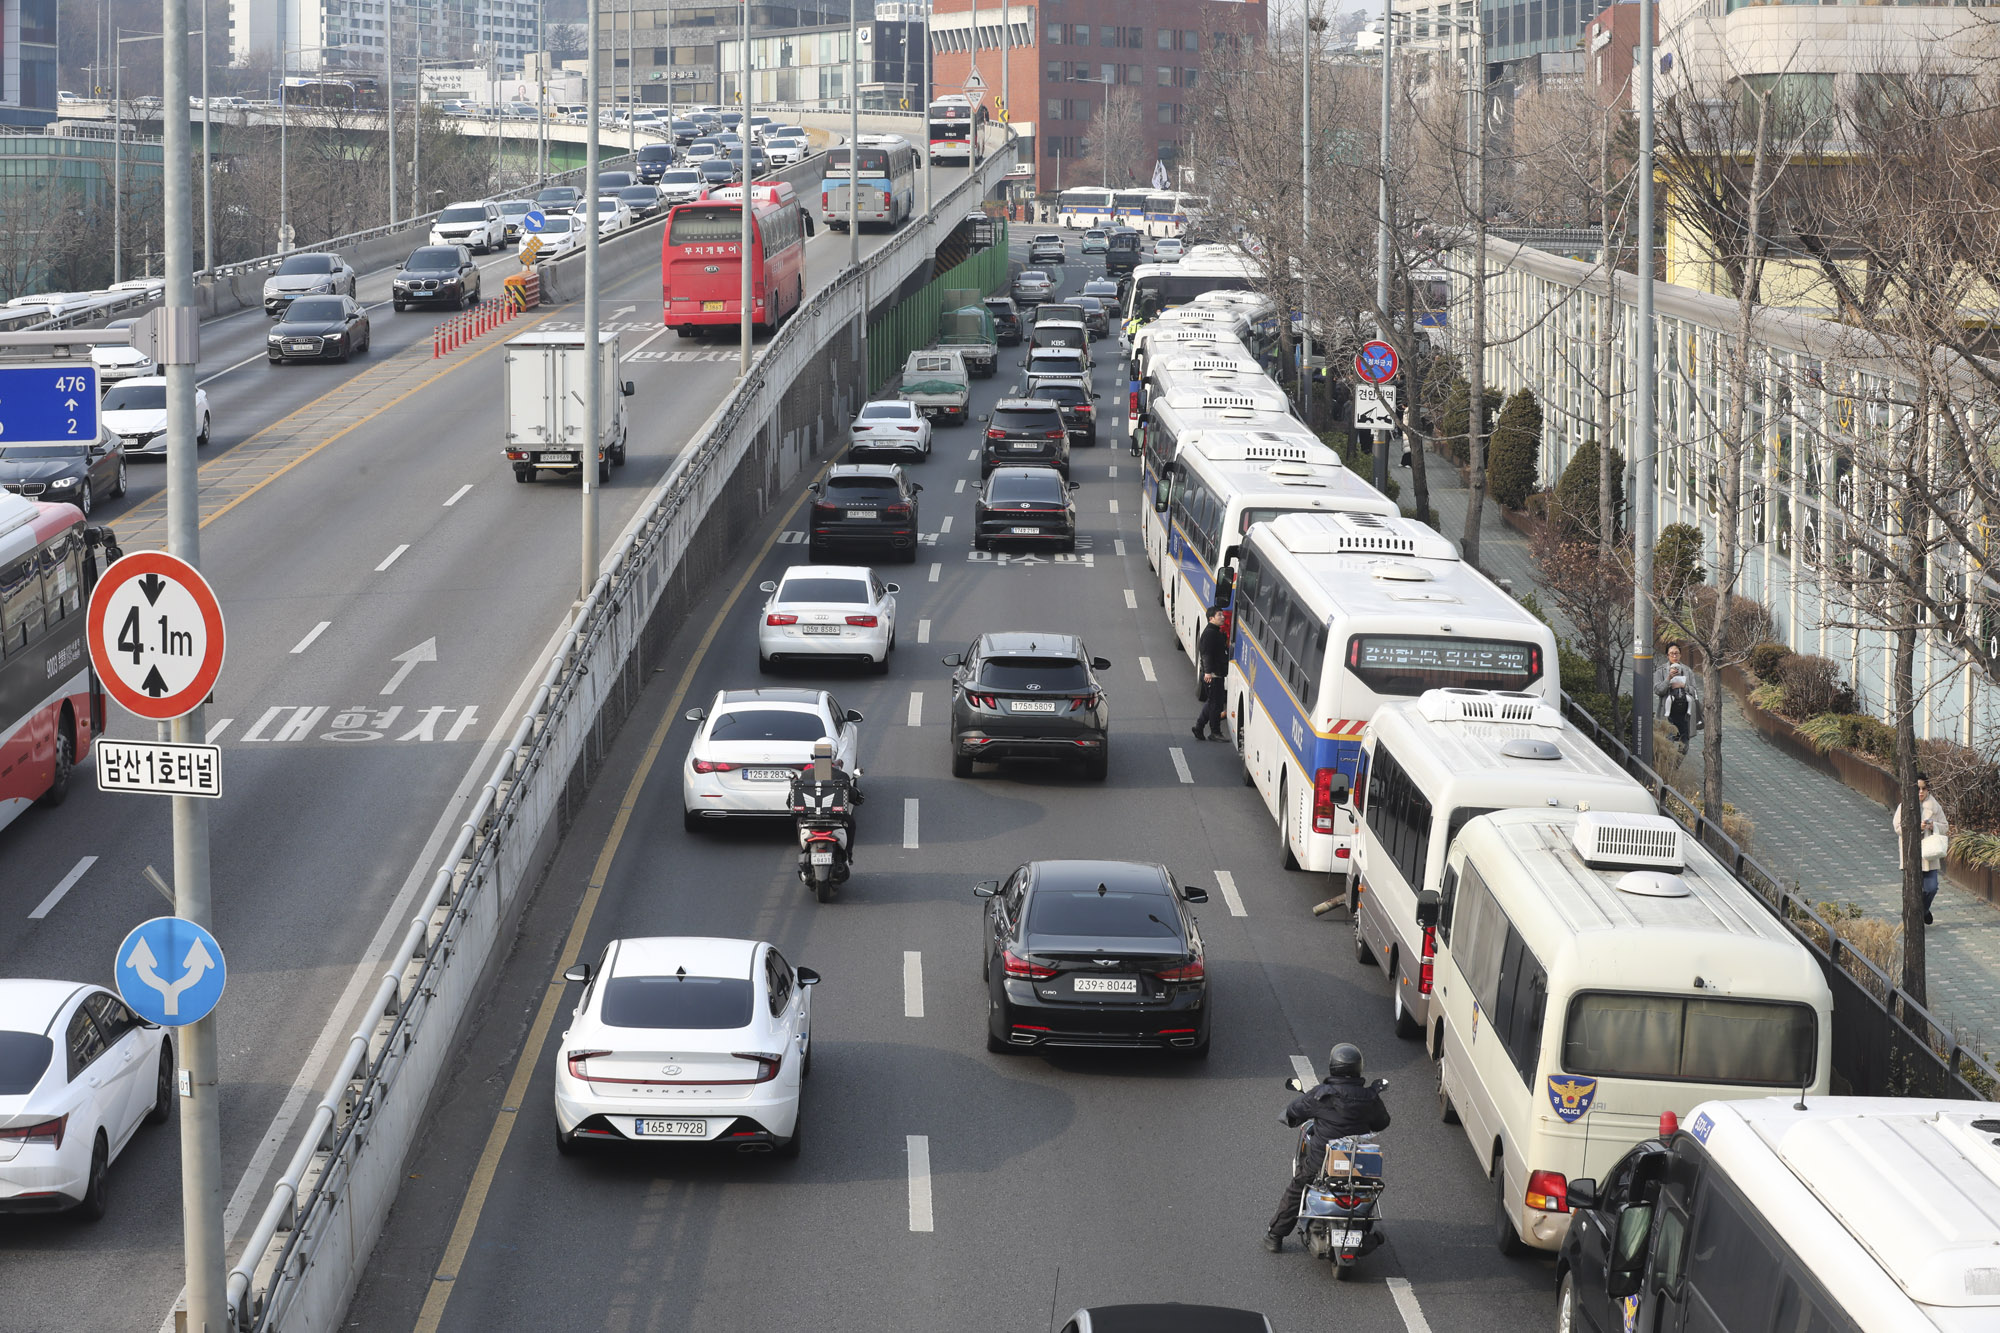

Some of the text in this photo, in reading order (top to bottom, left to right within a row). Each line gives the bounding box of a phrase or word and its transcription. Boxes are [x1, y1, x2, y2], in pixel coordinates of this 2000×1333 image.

[684, 246, 736, 255] 무지개투어
[1364, 358, 1392, 367] 정차금지
[56, 376, 86, 392] 476
[67, 418, 77, 434] 2
[118, 606, 192, 665] 4.1m
[240, 705, 480, 742] 대형차
[105, 748, 212, 788] 남산1호터널
[1078, 980, 1133, 990] 239수 8044
[645, 1121, 703, 1133] 165호 7928
